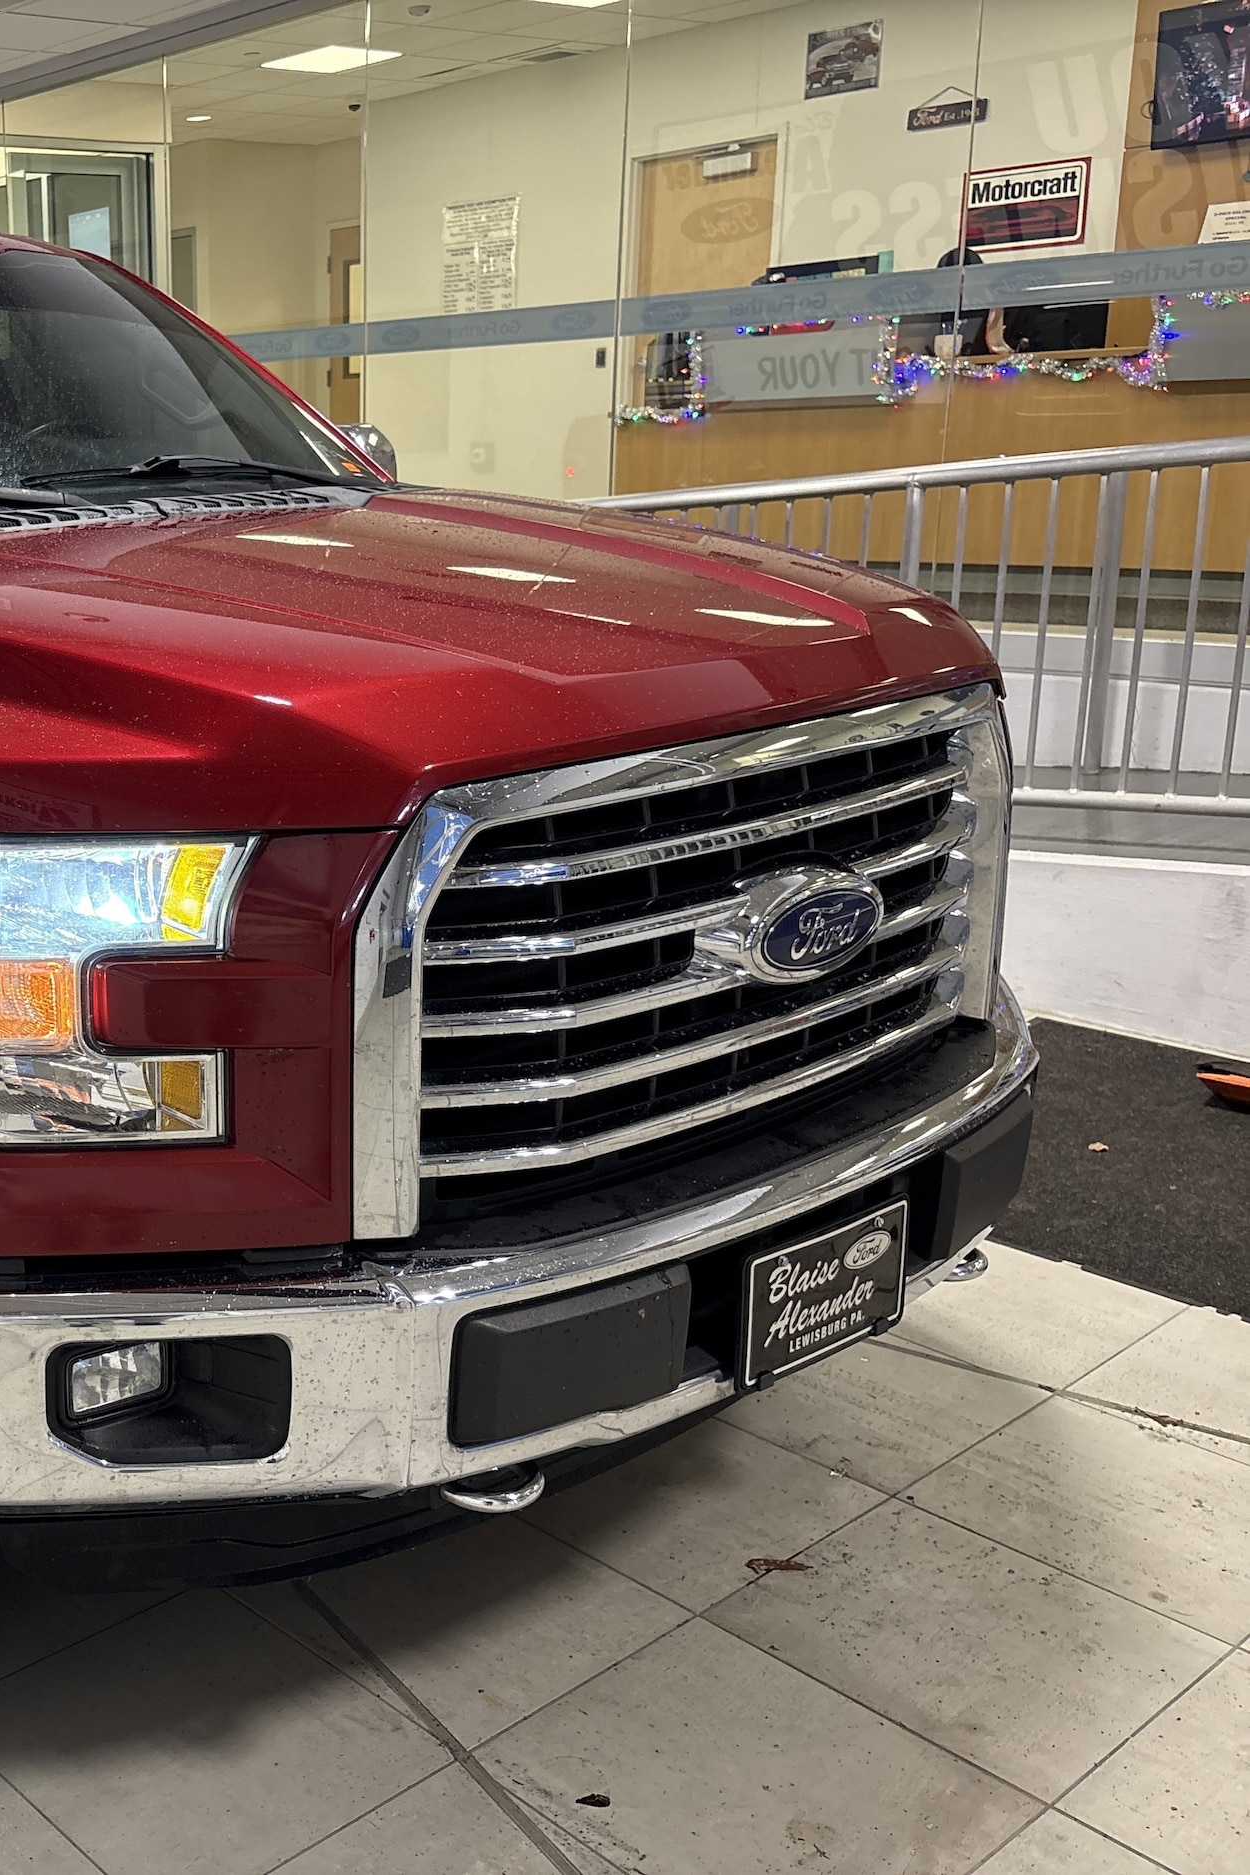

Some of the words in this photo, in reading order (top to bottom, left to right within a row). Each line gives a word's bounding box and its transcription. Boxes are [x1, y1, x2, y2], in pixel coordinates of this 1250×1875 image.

[913, 107, 944, 126] Ford
[971, 171, 1077, 204] Motorcraft
[791, 902, 859, 960] Ford
[853, 1238, 881, 1263] Ford
[768, 1258, 840, 1304] Blaise
[763, 1275, 874, 1348] Alexander
[789, 1316, 847, 1353] LEWISBURG
[850, 1309, 865, 1325] PA.
